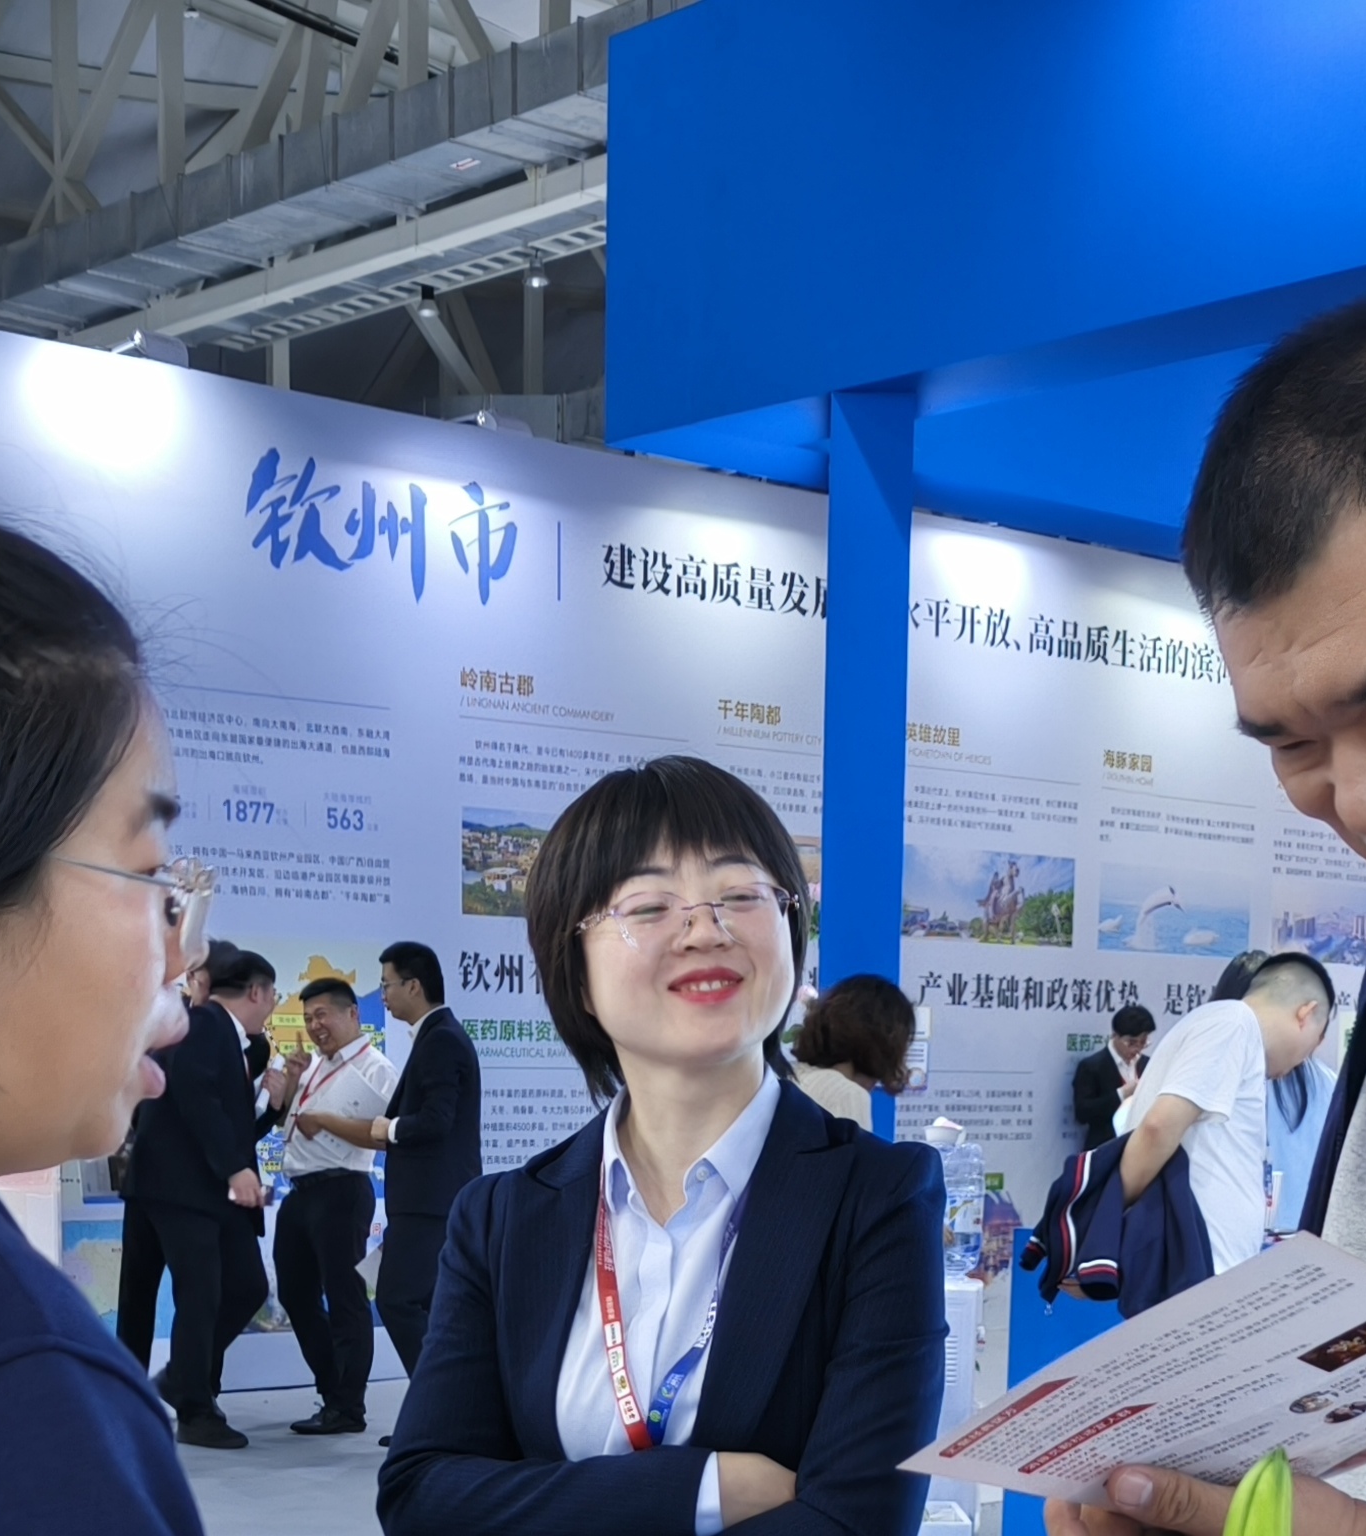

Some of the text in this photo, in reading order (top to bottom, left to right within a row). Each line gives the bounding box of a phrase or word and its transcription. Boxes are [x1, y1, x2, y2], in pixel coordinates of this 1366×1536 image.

[246, 446, 519, 606] 钦州市
[460, 667, 534, 698] 岭南古郡
[223, 799, 275, 824] 1877
[327, 807, 364, 831] 563
[1163, 982, 1211, 1017] 是钦
[1066, 1032, 1110, 1053] 医药产
